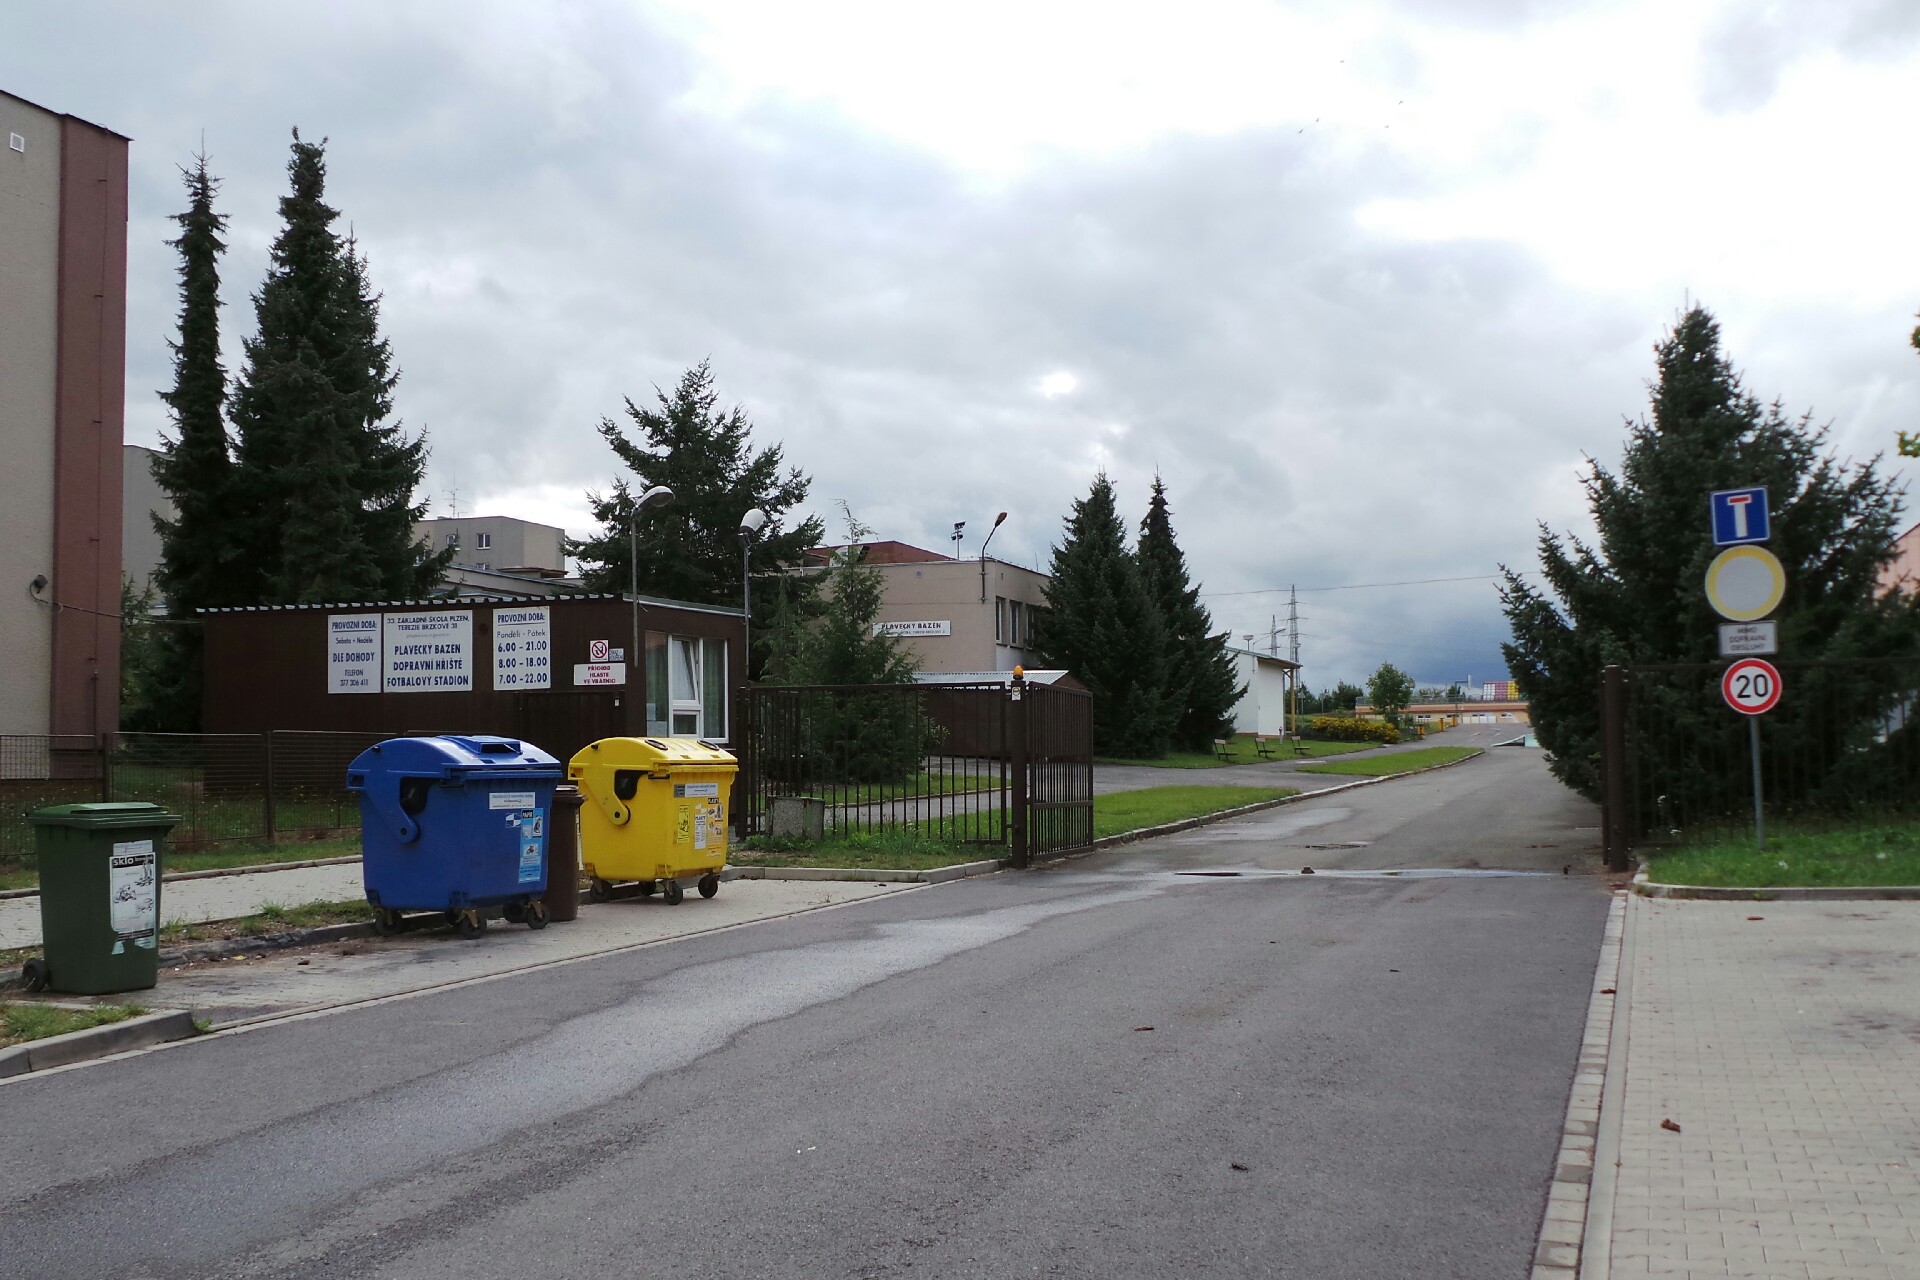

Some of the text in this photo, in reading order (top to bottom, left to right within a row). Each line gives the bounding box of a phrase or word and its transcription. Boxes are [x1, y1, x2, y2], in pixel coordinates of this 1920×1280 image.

[498, 612, 526, 623] PROVOZNÍ
[497, 630, 520, 638] Pondělí
[528, 628, 545, 637] Pátek
[394, 642, 460, 655] PLAVECKÝ BAZÉN
[498, 642, 516, 652] 6.00
[526, 640, 547, 651] 21.00
[333, 652, 375, 662] DLE DOHODY
[499, 658, 516, 668] 8.00
[526, 657, 547, 667] 18.00
[394, 658, 462, 671] DOPRAVNÍ HŘIŠTĚ
[387, 675, 468, 687] FOTBALOVÝ STADION
[499, 674, 516, 684] 7.00
[525, 673, 547, 683] 22.00
[1736, 674, 1768, 698] 20
[114, 857, 134, 866] sklo
